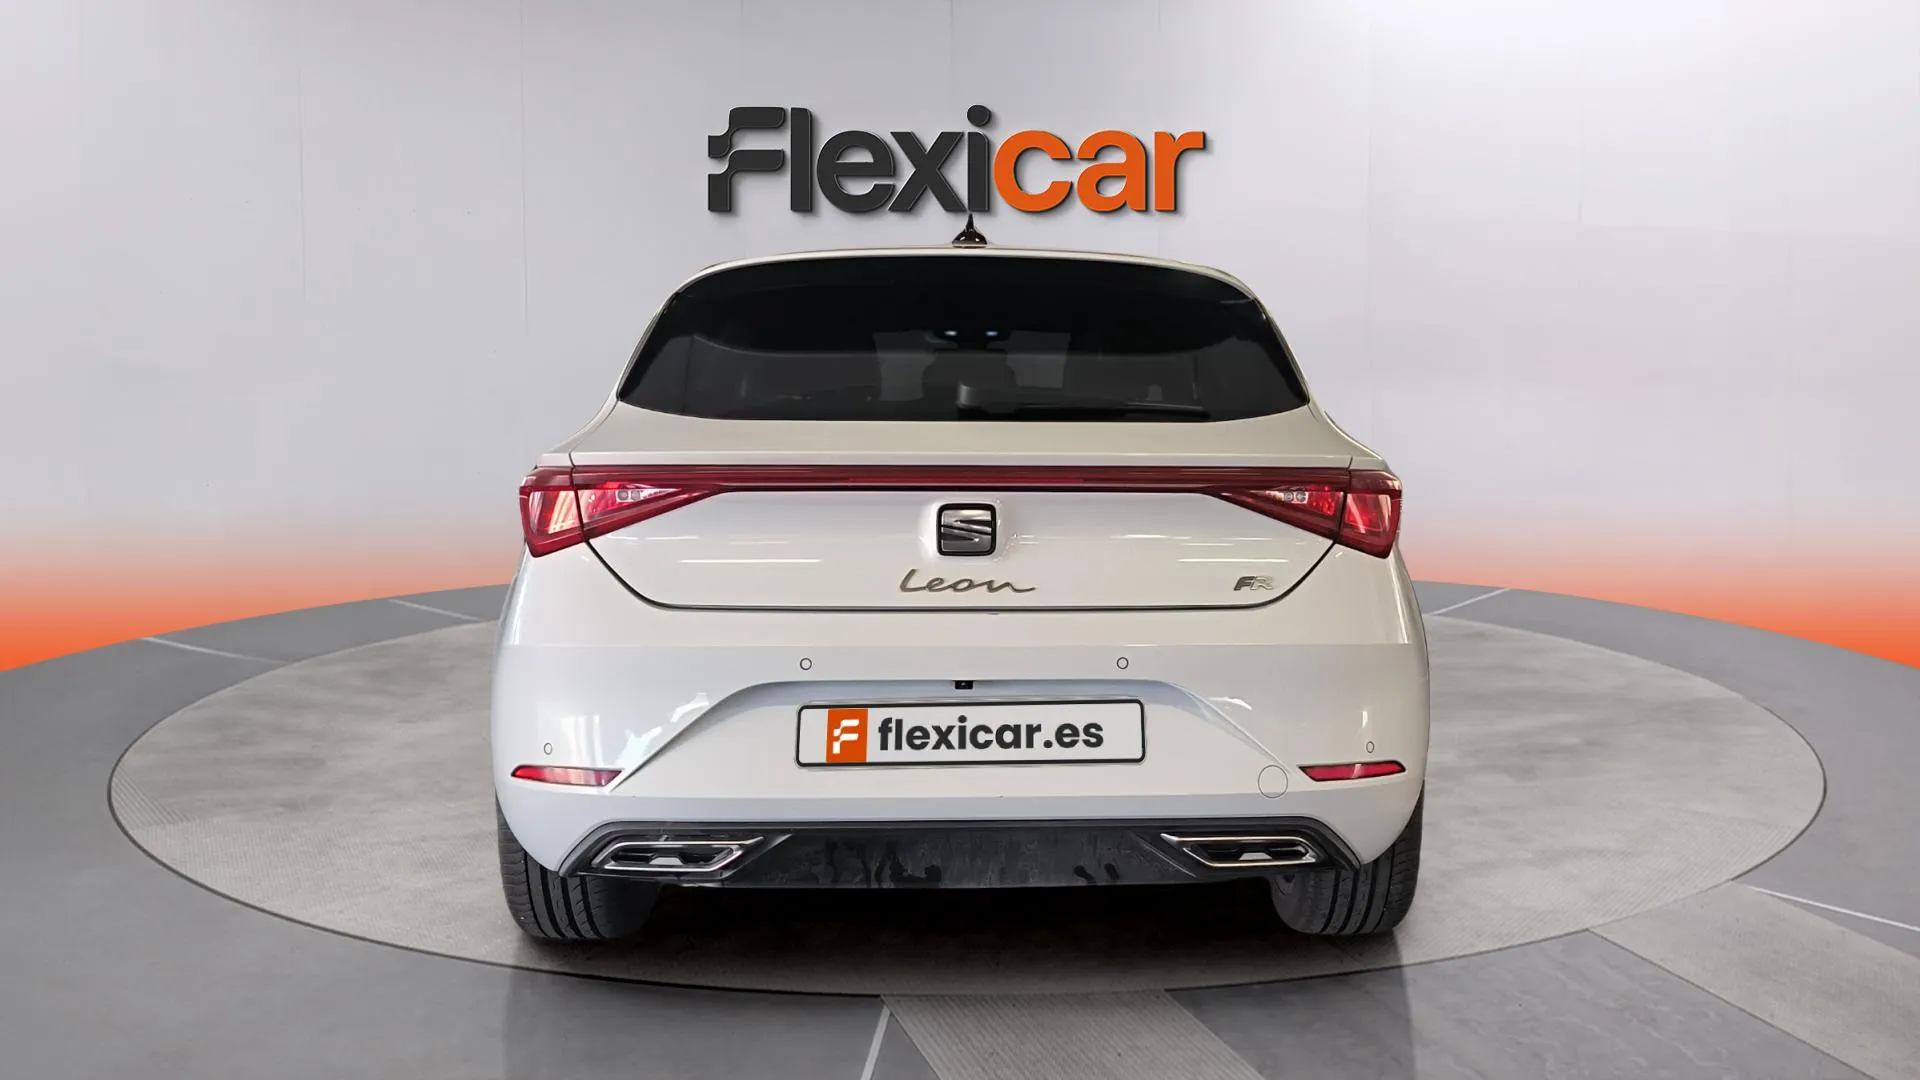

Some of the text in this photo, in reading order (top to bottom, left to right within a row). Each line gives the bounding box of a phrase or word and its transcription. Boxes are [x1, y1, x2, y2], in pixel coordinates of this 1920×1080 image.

[708, 104, 1205, 212] Flexicar
[899, 568, 1037, 594] Leon
[1233, 575, 1275, 591] FR
[878, 714, 1104, 751] flexicar.es
